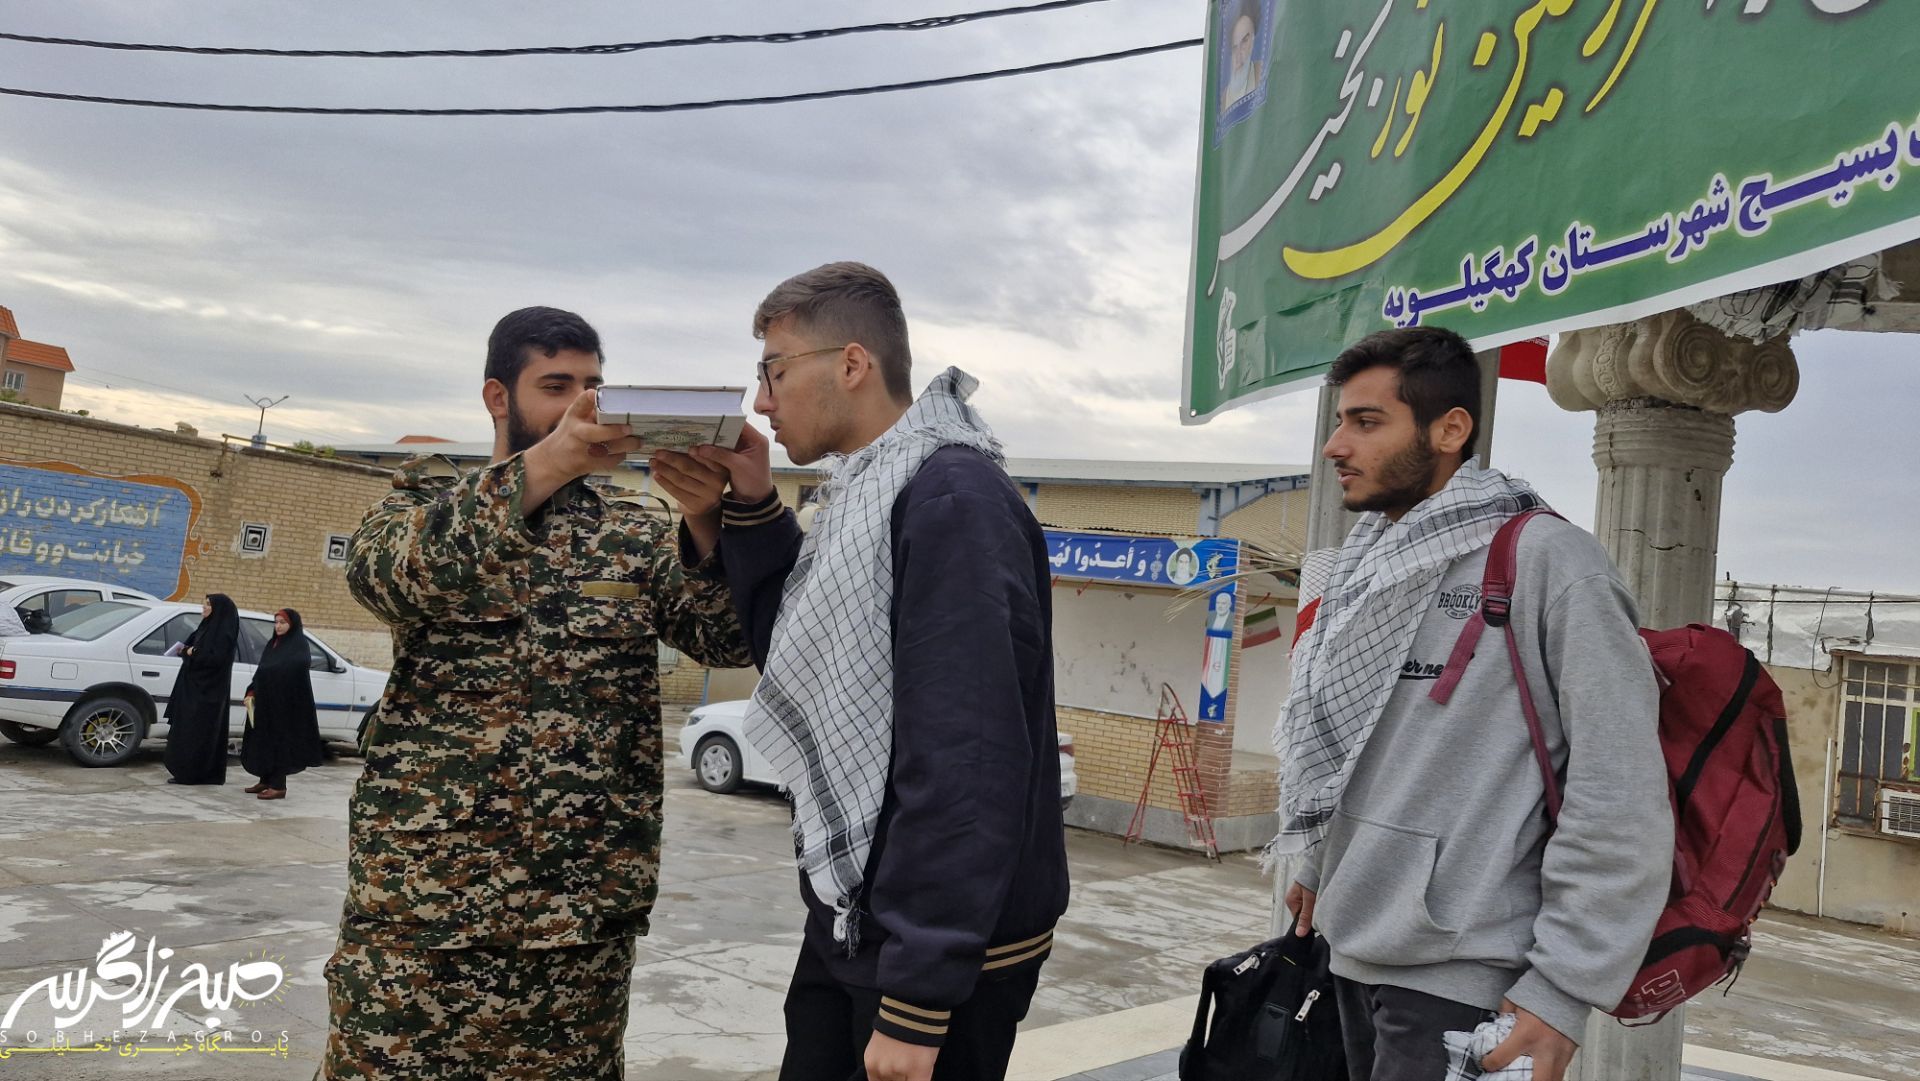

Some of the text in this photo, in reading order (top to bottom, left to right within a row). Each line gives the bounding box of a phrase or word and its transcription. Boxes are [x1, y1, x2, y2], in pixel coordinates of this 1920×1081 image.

[1738, 127, 1899, 232] بسیج
[1542, 178, 1731, 292] شهرستان
[1383, 240, 1535, 328] کهگیلویه
[1437, 591, 1482, 610] BROOKLY
